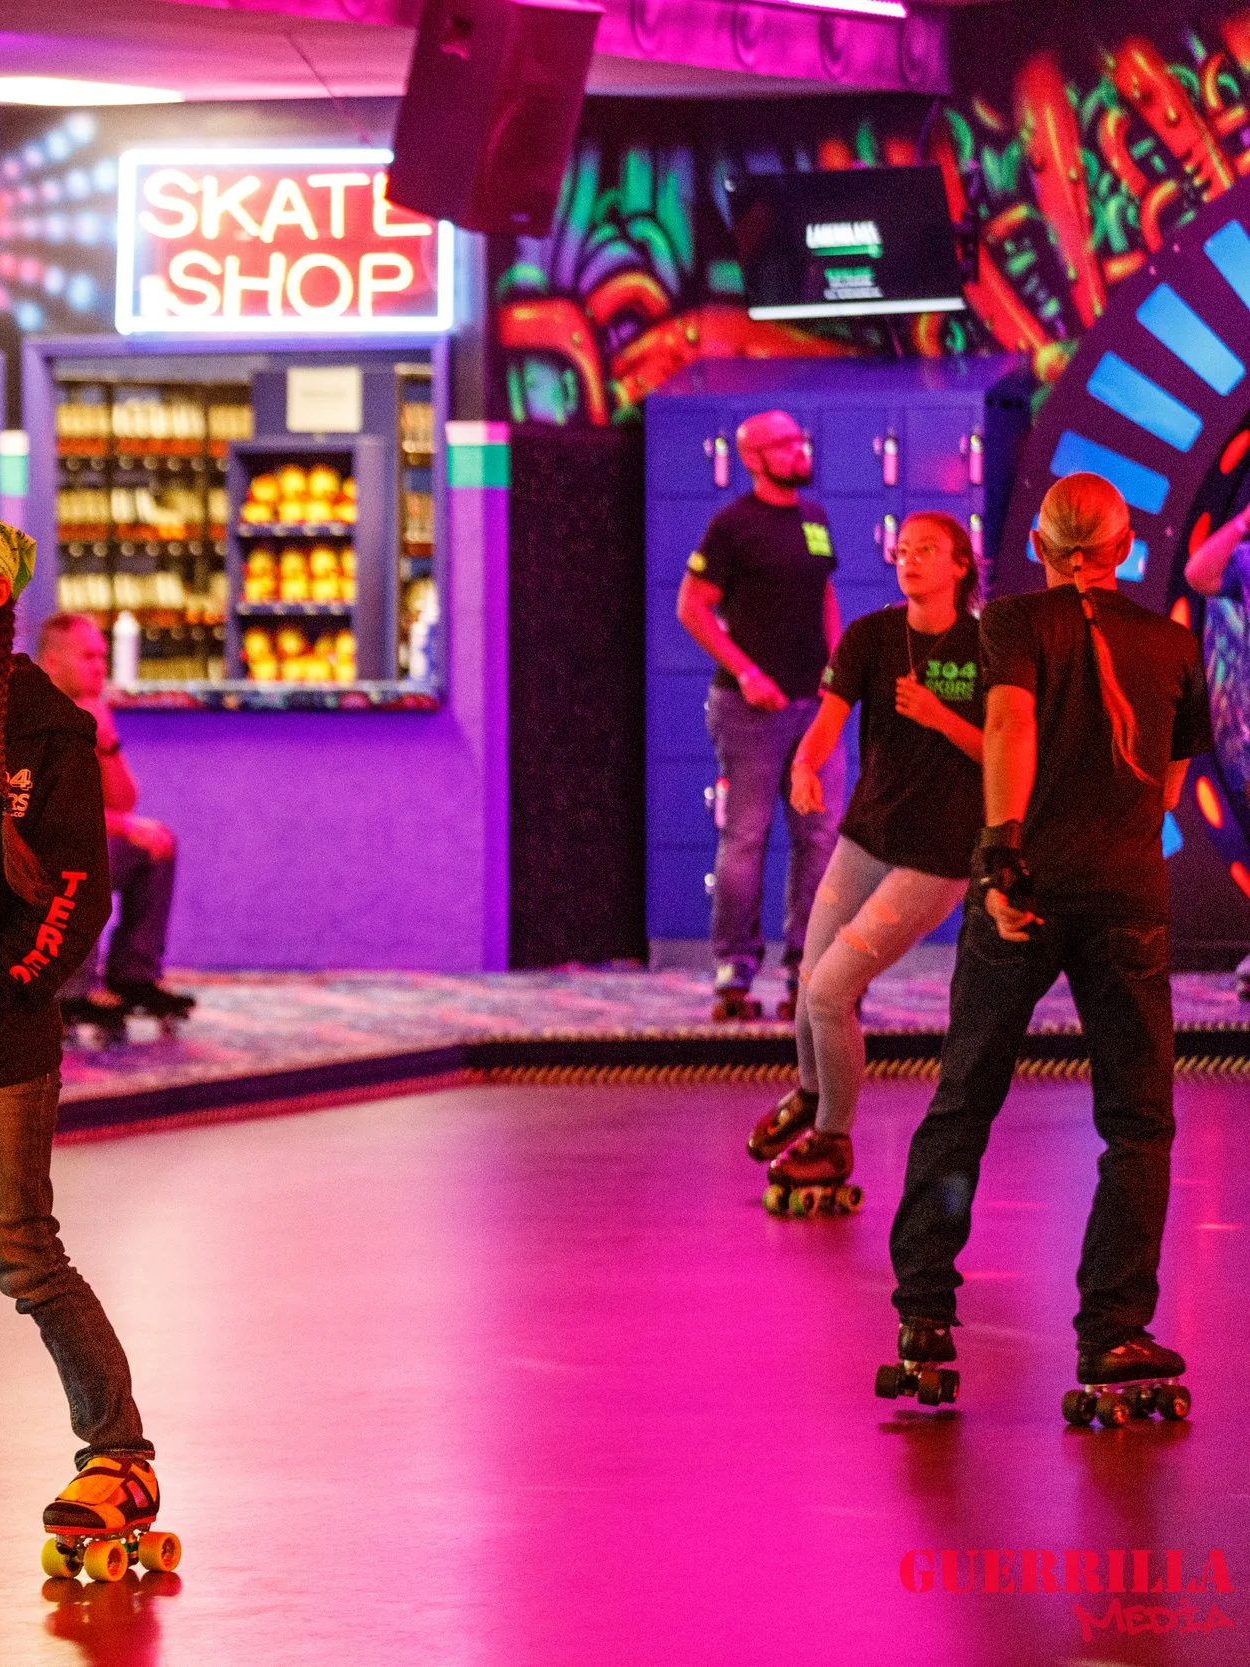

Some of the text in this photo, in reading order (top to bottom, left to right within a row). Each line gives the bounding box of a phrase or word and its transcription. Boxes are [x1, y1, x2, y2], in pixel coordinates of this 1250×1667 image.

[139, 168, 433, 243] SKATE
[168, 250, 415, 318] SHOP
[925, 659, 977, 679] 304
